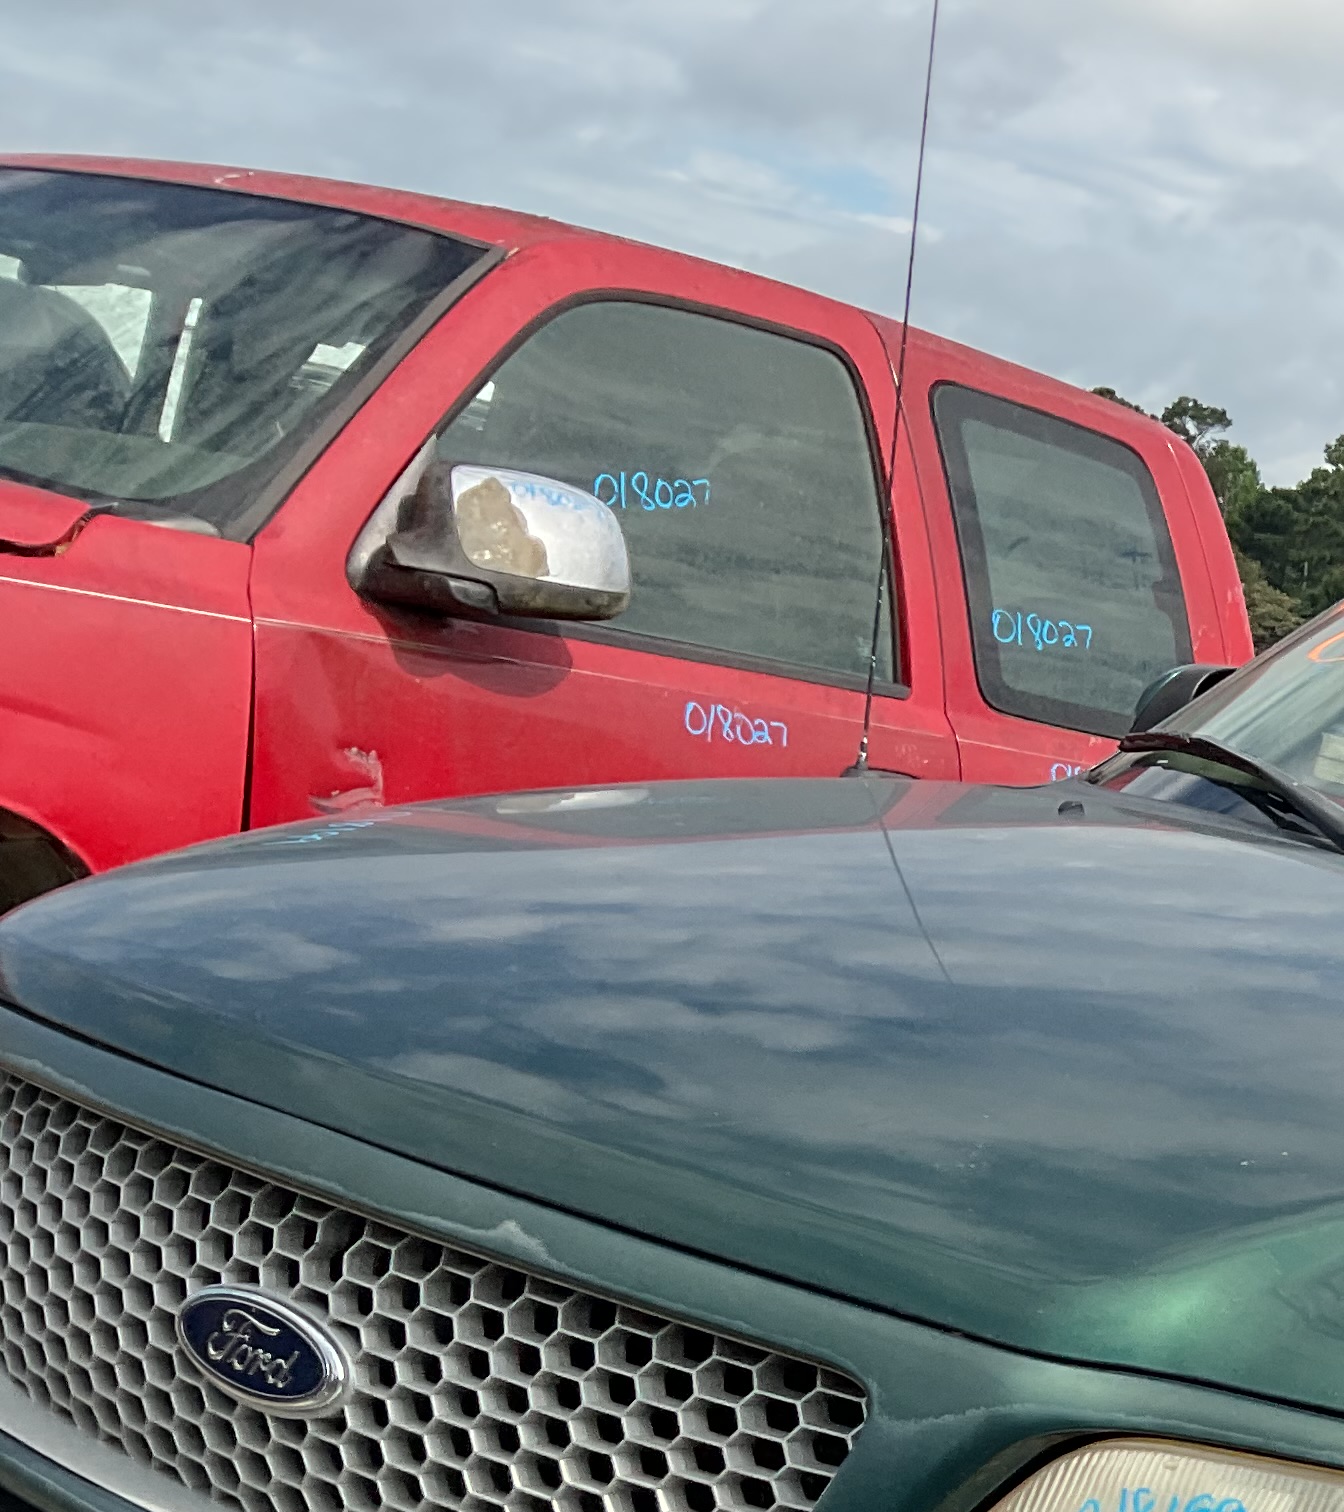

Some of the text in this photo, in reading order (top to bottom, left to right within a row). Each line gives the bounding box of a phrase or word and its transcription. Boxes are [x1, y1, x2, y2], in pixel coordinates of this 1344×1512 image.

[594, 471, 710, 511] 018027
[991, 608, 1093, 651] 018027
[685, 701, 788, 748] 018027
